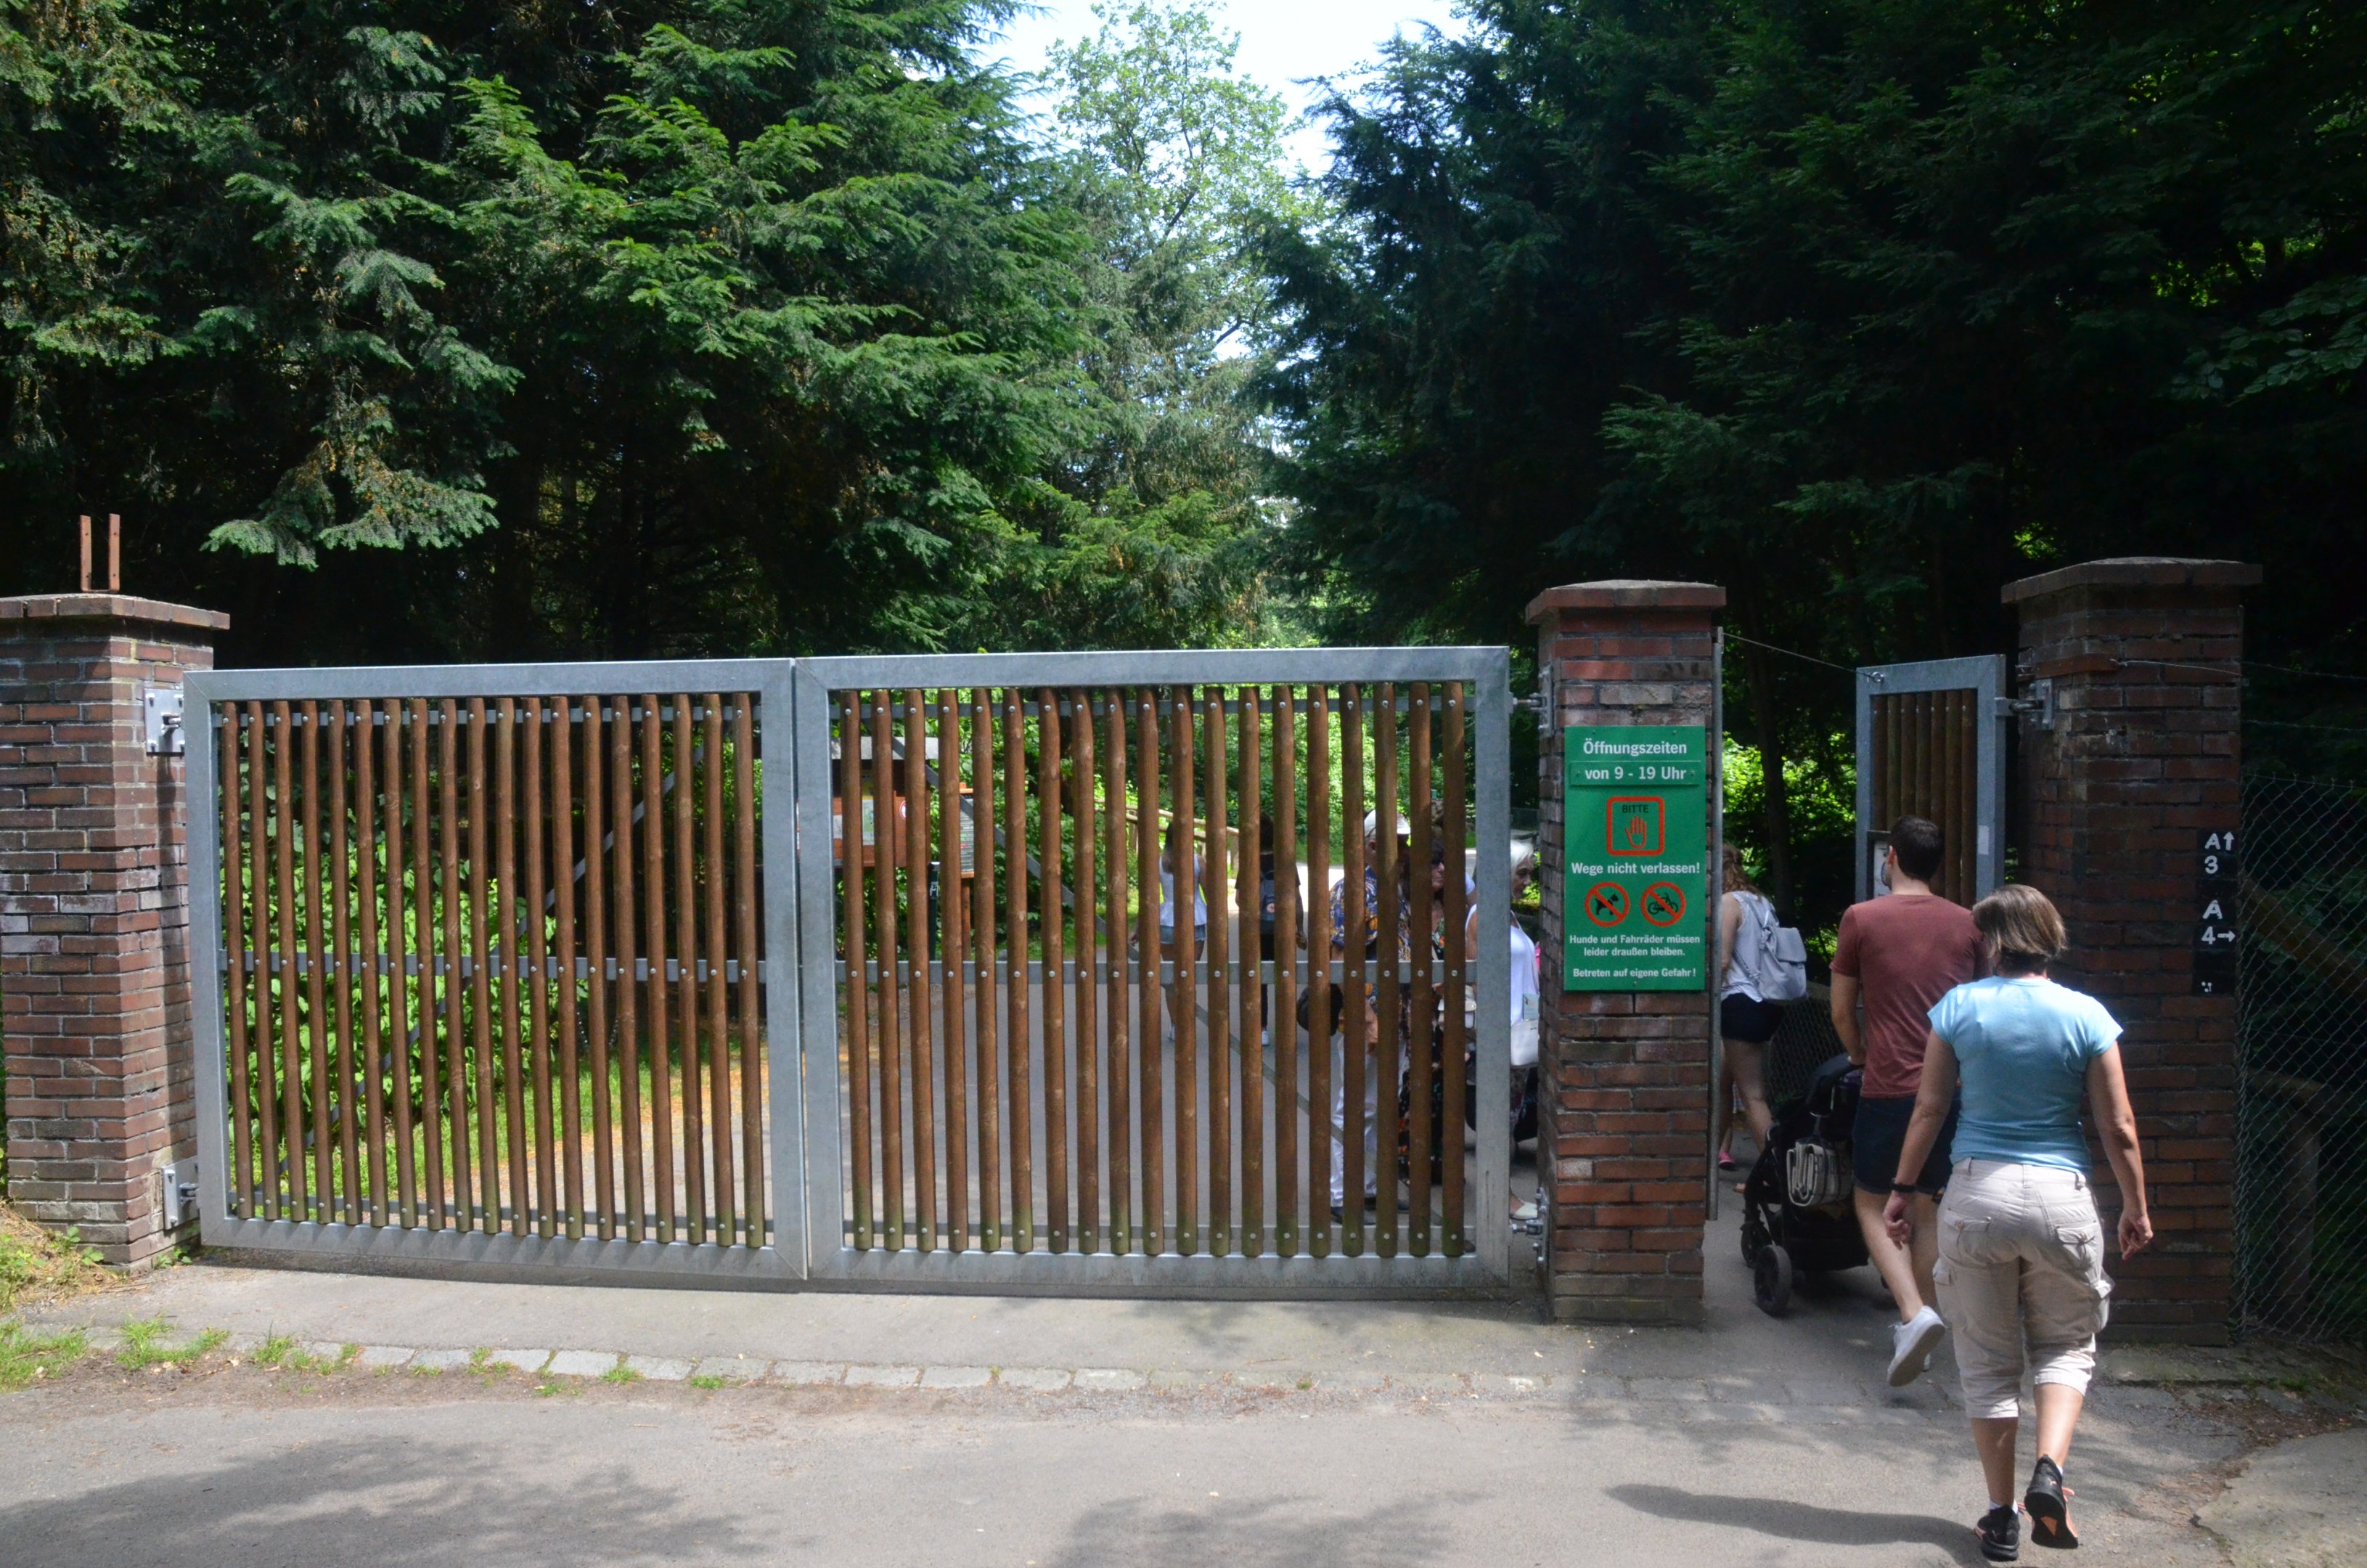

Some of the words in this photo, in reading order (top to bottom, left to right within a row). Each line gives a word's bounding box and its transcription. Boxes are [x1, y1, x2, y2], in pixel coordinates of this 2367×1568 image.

[1583, 738, 1687, 756] Öffnungszeiten
[1585, 769, 1609, 780] von
[1614, 767, 1624, 780] 9
[1639, 767, 1656, 780] 19
[1661, 767, 1687, 780] Uhr
[1622, 804, 1649, 814] BITTE
[2204, 833, 2221, 850] A
[1571, 862, 1603, 875] Wege
[1607, 862, 1637, 874] nicht
[1640, 862, 1700, 874] verlassen!
[2204, 855, 2218, 874] 3
[2202, 899, 2223, 920] A
[1569, 934, 1598, 944] Hunde
[1601, 934, 1618, 944] und
[1620, 934, 1664, 944] Fahrräder
[1667, 934, 1700, 944] müssen
[2201, 926, 2216, 945] 4
[1584, 947, 1608, 956] leider
[1611, 947, 1648, 956] draußen
[1651, 947, 1685, 956] bleiben.
[1573, 968, 1610, 977] Betreten
[1613, 968, 1628, 977] auf
[1630, 968, 1659, 979] eigene
